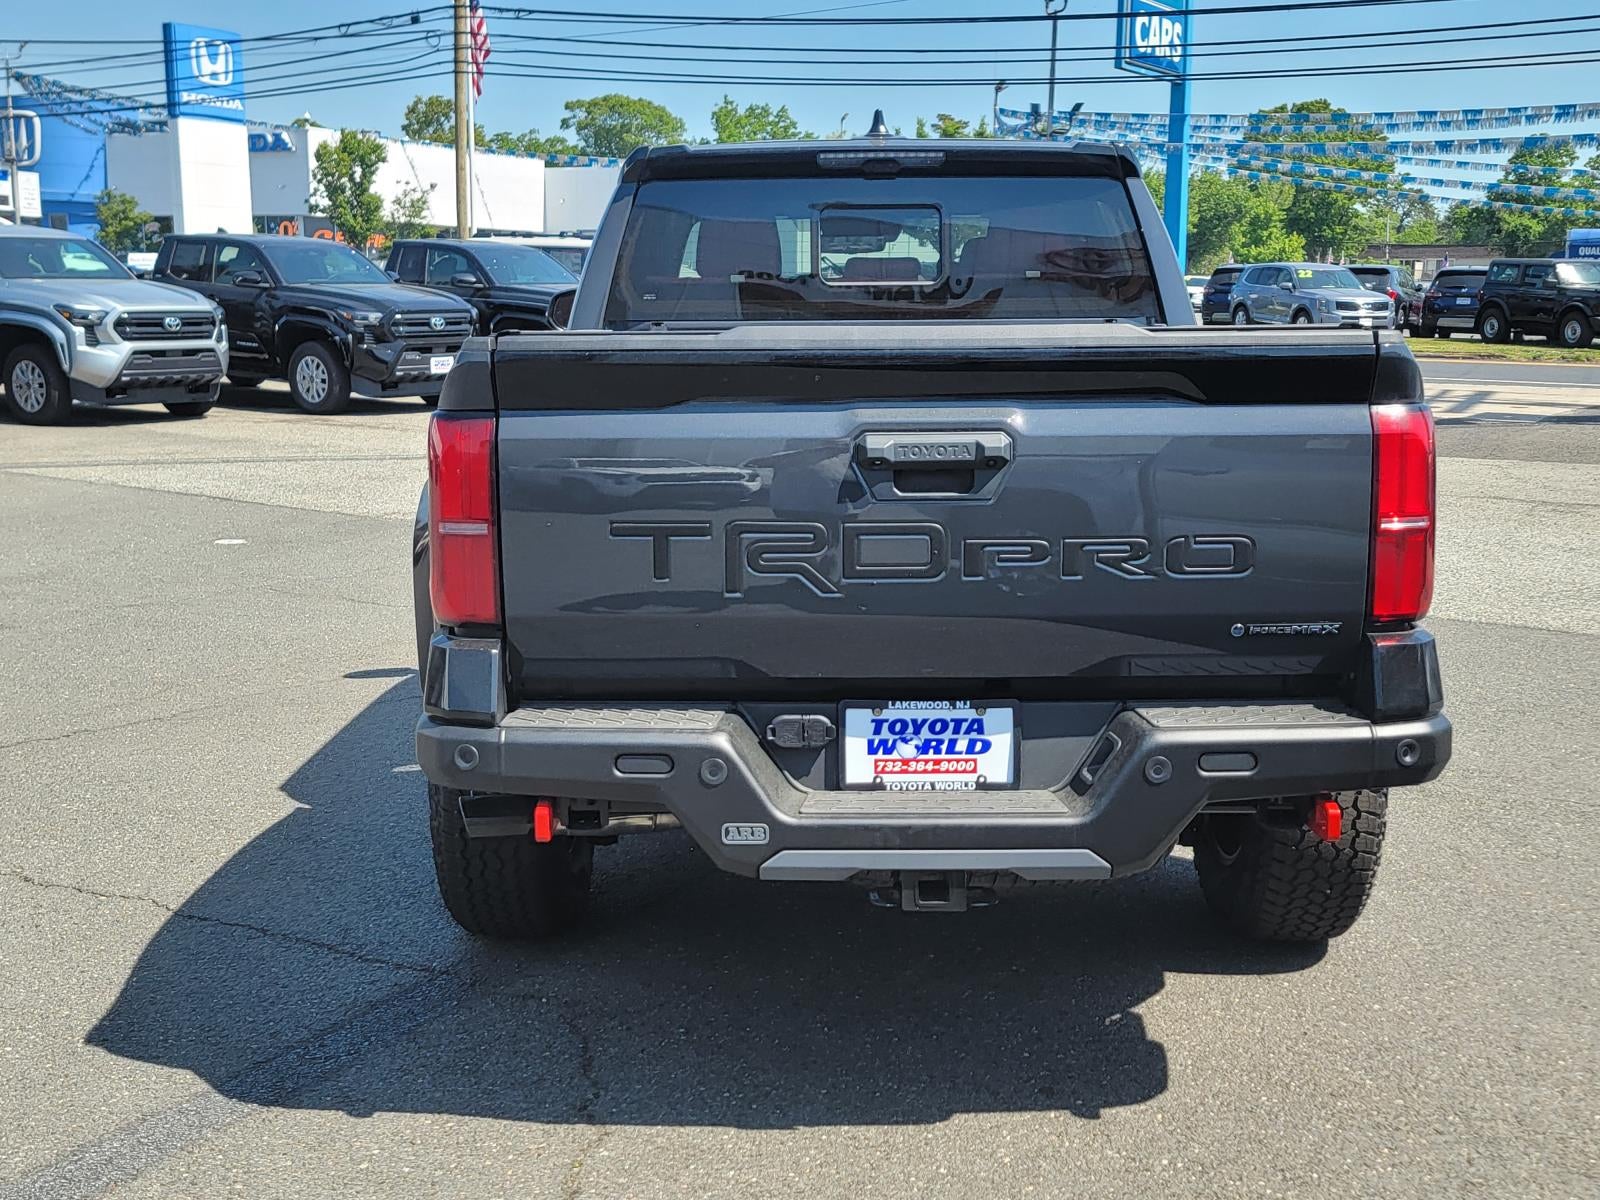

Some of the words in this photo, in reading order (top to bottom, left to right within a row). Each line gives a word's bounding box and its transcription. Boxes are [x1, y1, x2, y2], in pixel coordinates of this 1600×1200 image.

[1135, 10, 1182, 62] CARS
[181, 91, 244, 110] HONDA
[898, 445, 971, 459] TOYOTA
[609, 520, 949, 598] TRD
[961, 535, 1256, 581] PRO
[888, 701, 953, 709] LAKEWOOD,
[956, 701, 970, 709] NJ
[871, 718, 985, 735] TOYOTA
[876, 761, 975, 771] 732-364-9000
[885, 781, 932, 790] TOYOTA
[934, 781, 976, 790] WORLD
[726, 828, 765, 840] ARB
